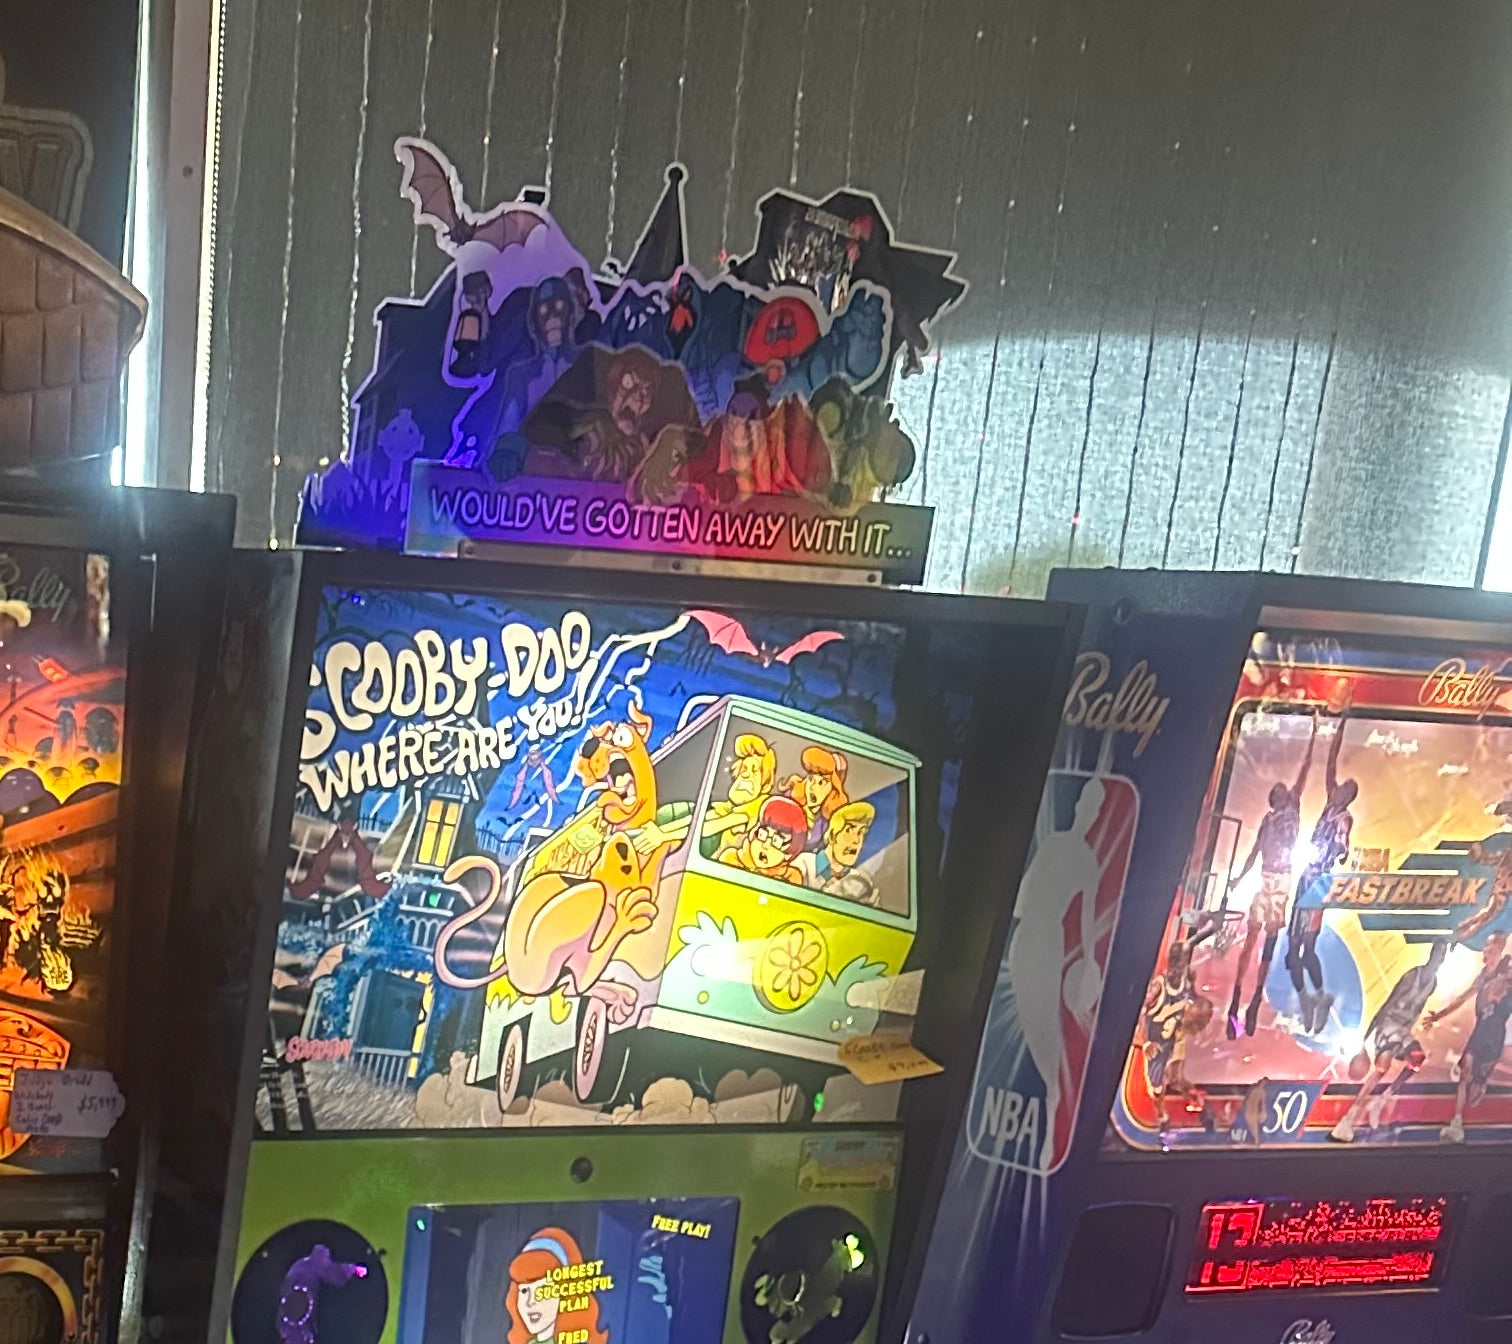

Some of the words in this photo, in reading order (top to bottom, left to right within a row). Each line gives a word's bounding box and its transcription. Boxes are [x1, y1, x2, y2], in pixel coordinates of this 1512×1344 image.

[430, 486, 576, 533] WOULD'VE
[584, 500, 699, 542] GOTTEN
[704, 513, 783, 549] AWAY
[782, 516, 858, 552] WITH
[861, 523, 912, 558] IT...
[1063, 651, 1172, 757] Bally
[1418, 657, 1501, 720] Bally
[300, 727, 445, 813] WHERE
[454, 716, 516, 777] ARE
[1322, 876, 1487, 905] FASTBREAK
[979, 1084, 1044, 1148] NBA
[1262, 1090, 1308, 1134] 50
[651, 1214, 678, 1233] FREE
[534, 1276, 615, 1302] SUCCESSFUL
[545, 1260, 604, 1283] LONGEST
[559, 1296, 589, 1313] PLAN
